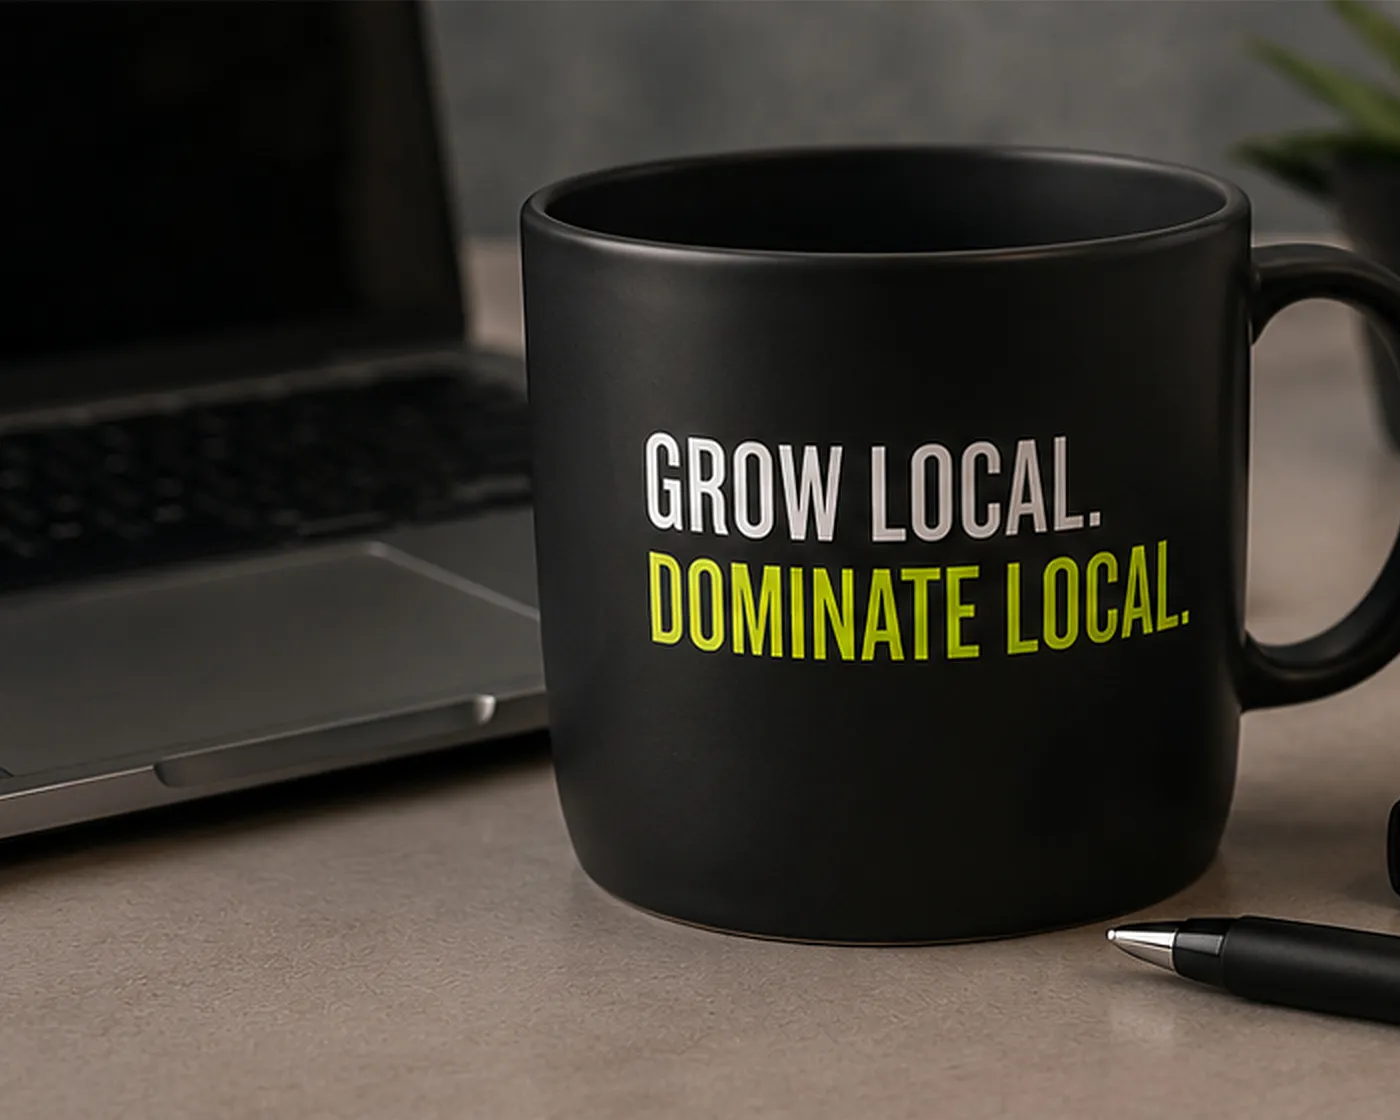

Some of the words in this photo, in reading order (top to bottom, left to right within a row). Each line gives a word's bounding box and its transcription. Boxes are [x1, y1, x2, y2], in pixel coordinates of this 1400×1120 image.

[645, 432, 843, 541] GROW
[871, 436, 1101, 542] LOCAL.
[649, 551, 980, 661] DOMINATE
[1006, 540, 1190, 655] LOCAL.
